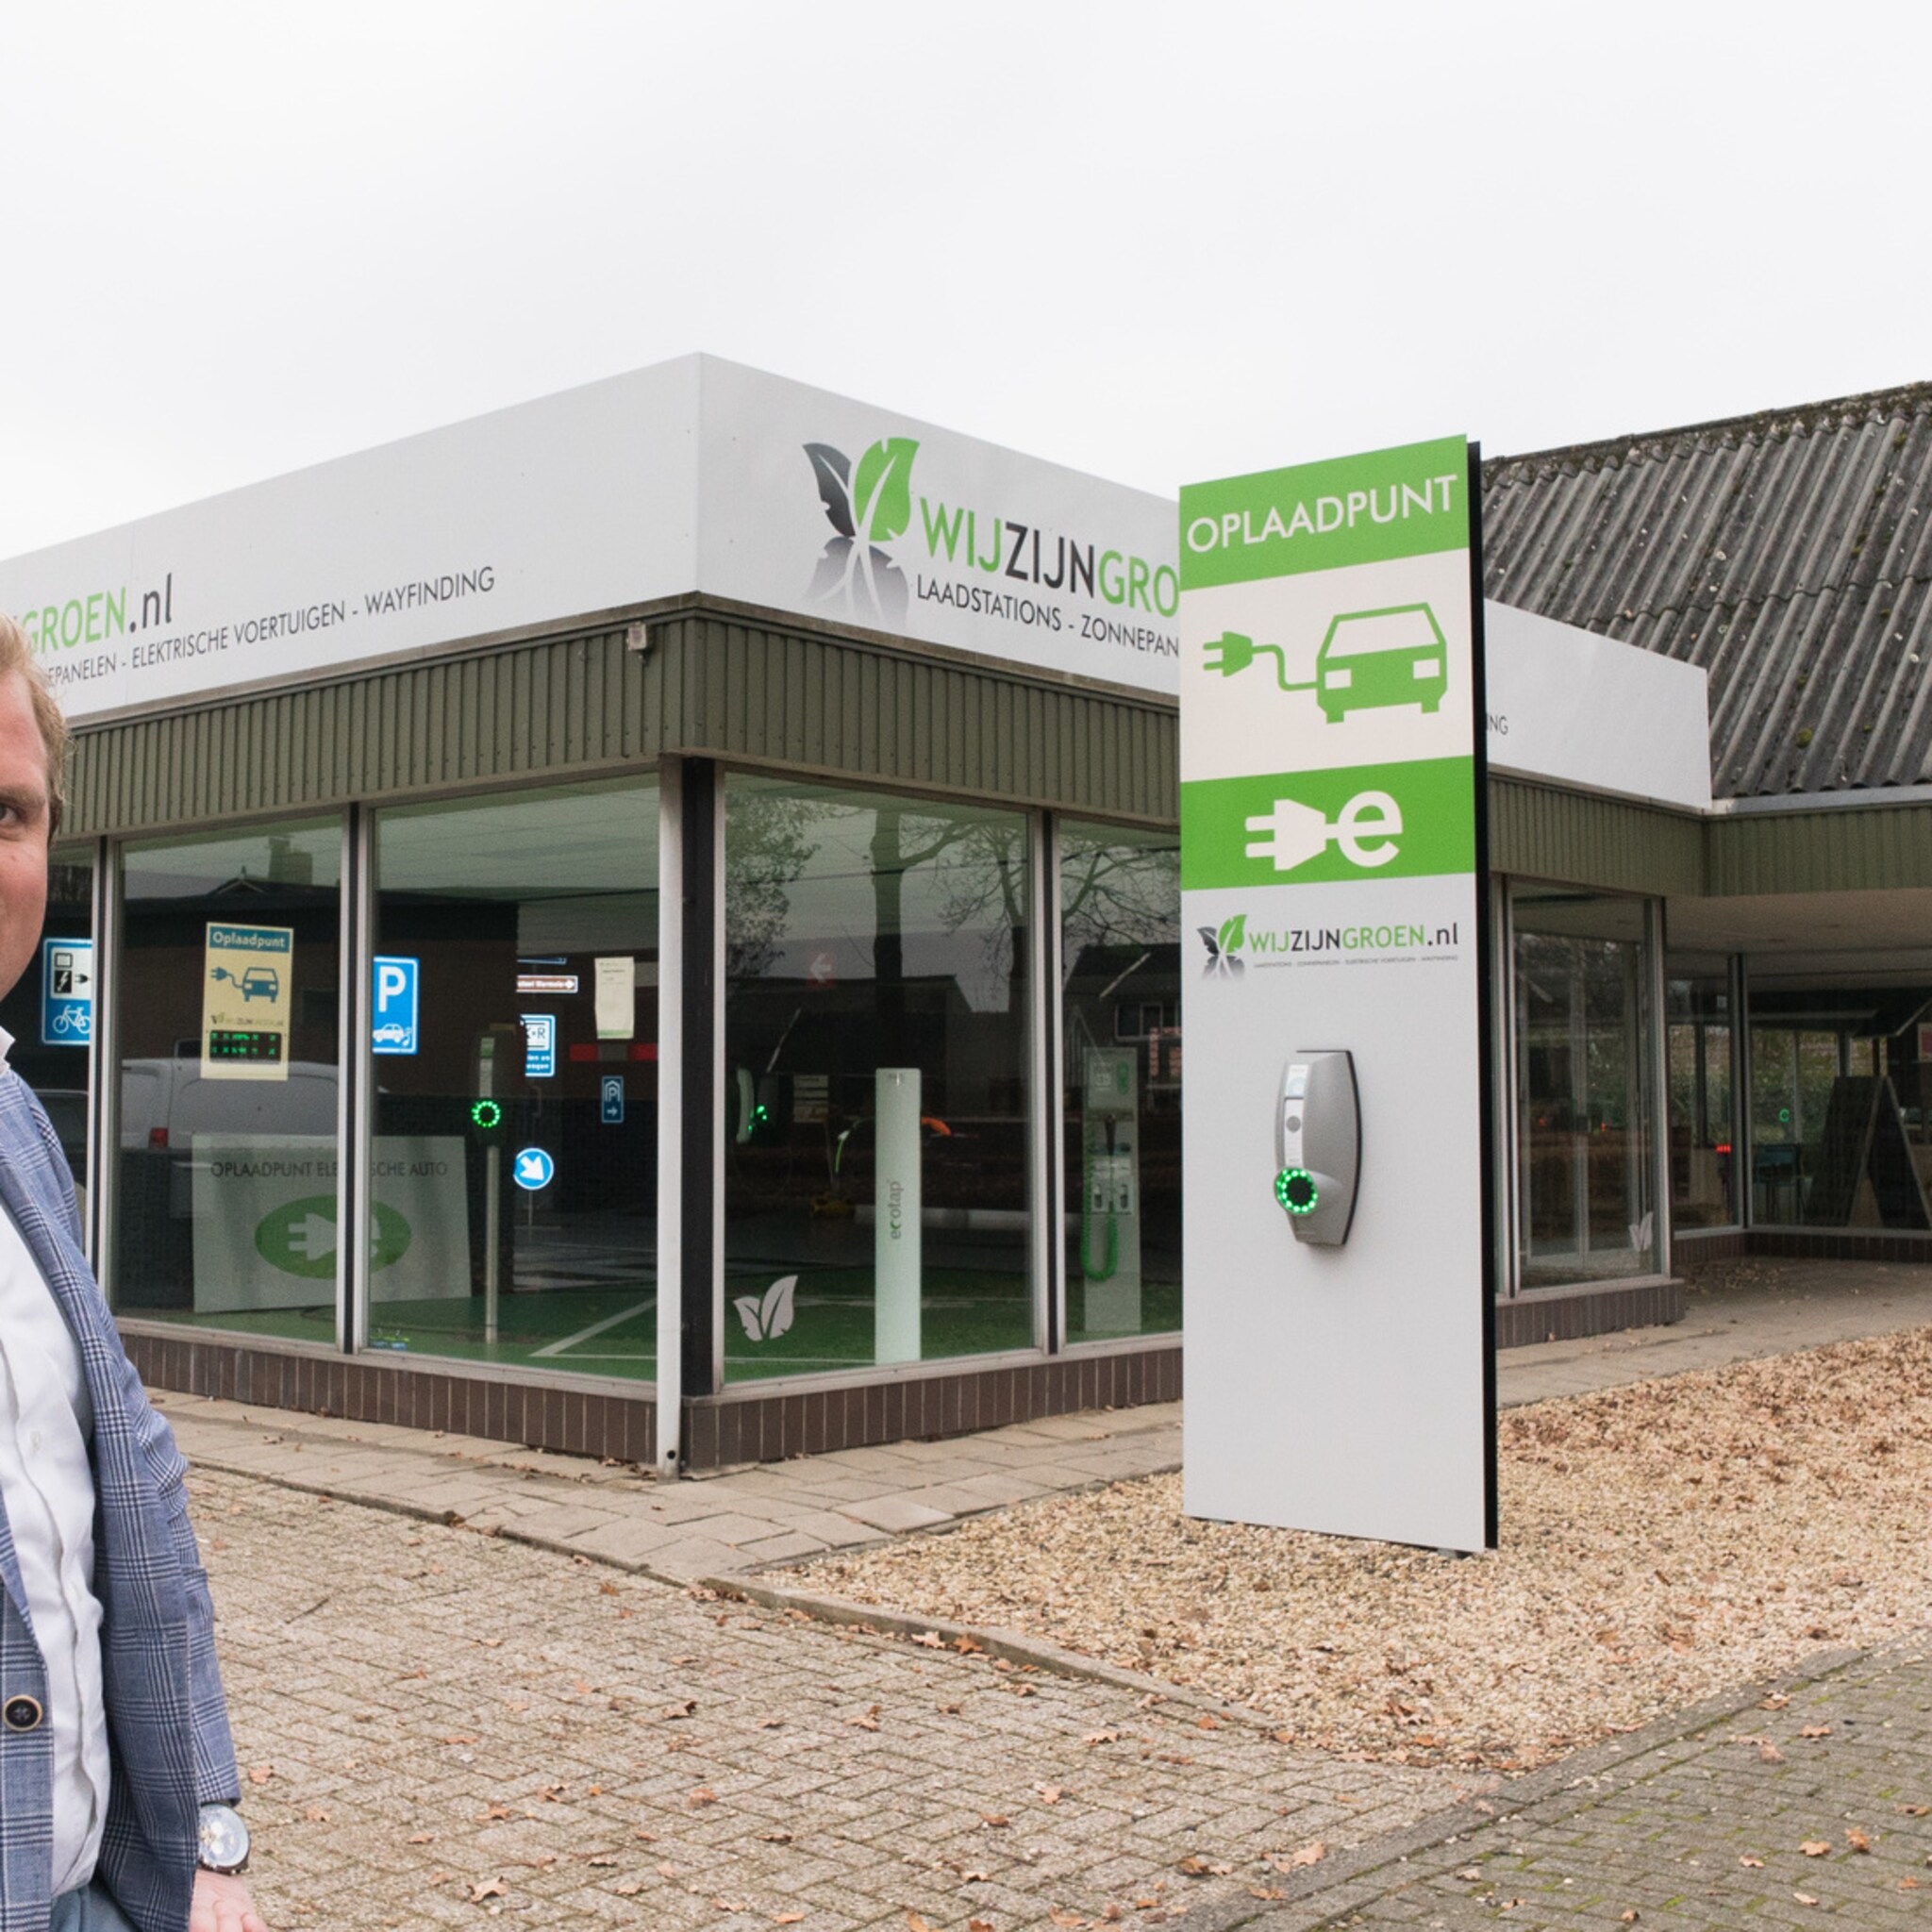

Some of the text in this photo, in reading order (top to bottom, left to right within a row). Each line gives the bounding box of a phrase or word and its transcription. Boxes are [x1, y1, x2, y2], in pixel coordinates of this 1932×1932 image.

[1187, 474, 1457, 553] OPLAADPUNT
[132, 626, 228, 669] ELEKTRISCHE
[233, 600, 345, 644] VOERTUIGEN
[364, 565, 494, 616] WAYFINDING
[917, 574, 1062, 631] LAADSTATIONS
[212, 931, 286, 948] Oplaadpunt
[1248, 922, 1458, 954] WIJZIJNGROEN.nl
[378, 965, 407, 1012] P
[210, 1160, 312, 1177] OPLAADPUNT
[408, 1160, 448, 1177] AUTO
[887, 1179, 905, 1241] ecotap
